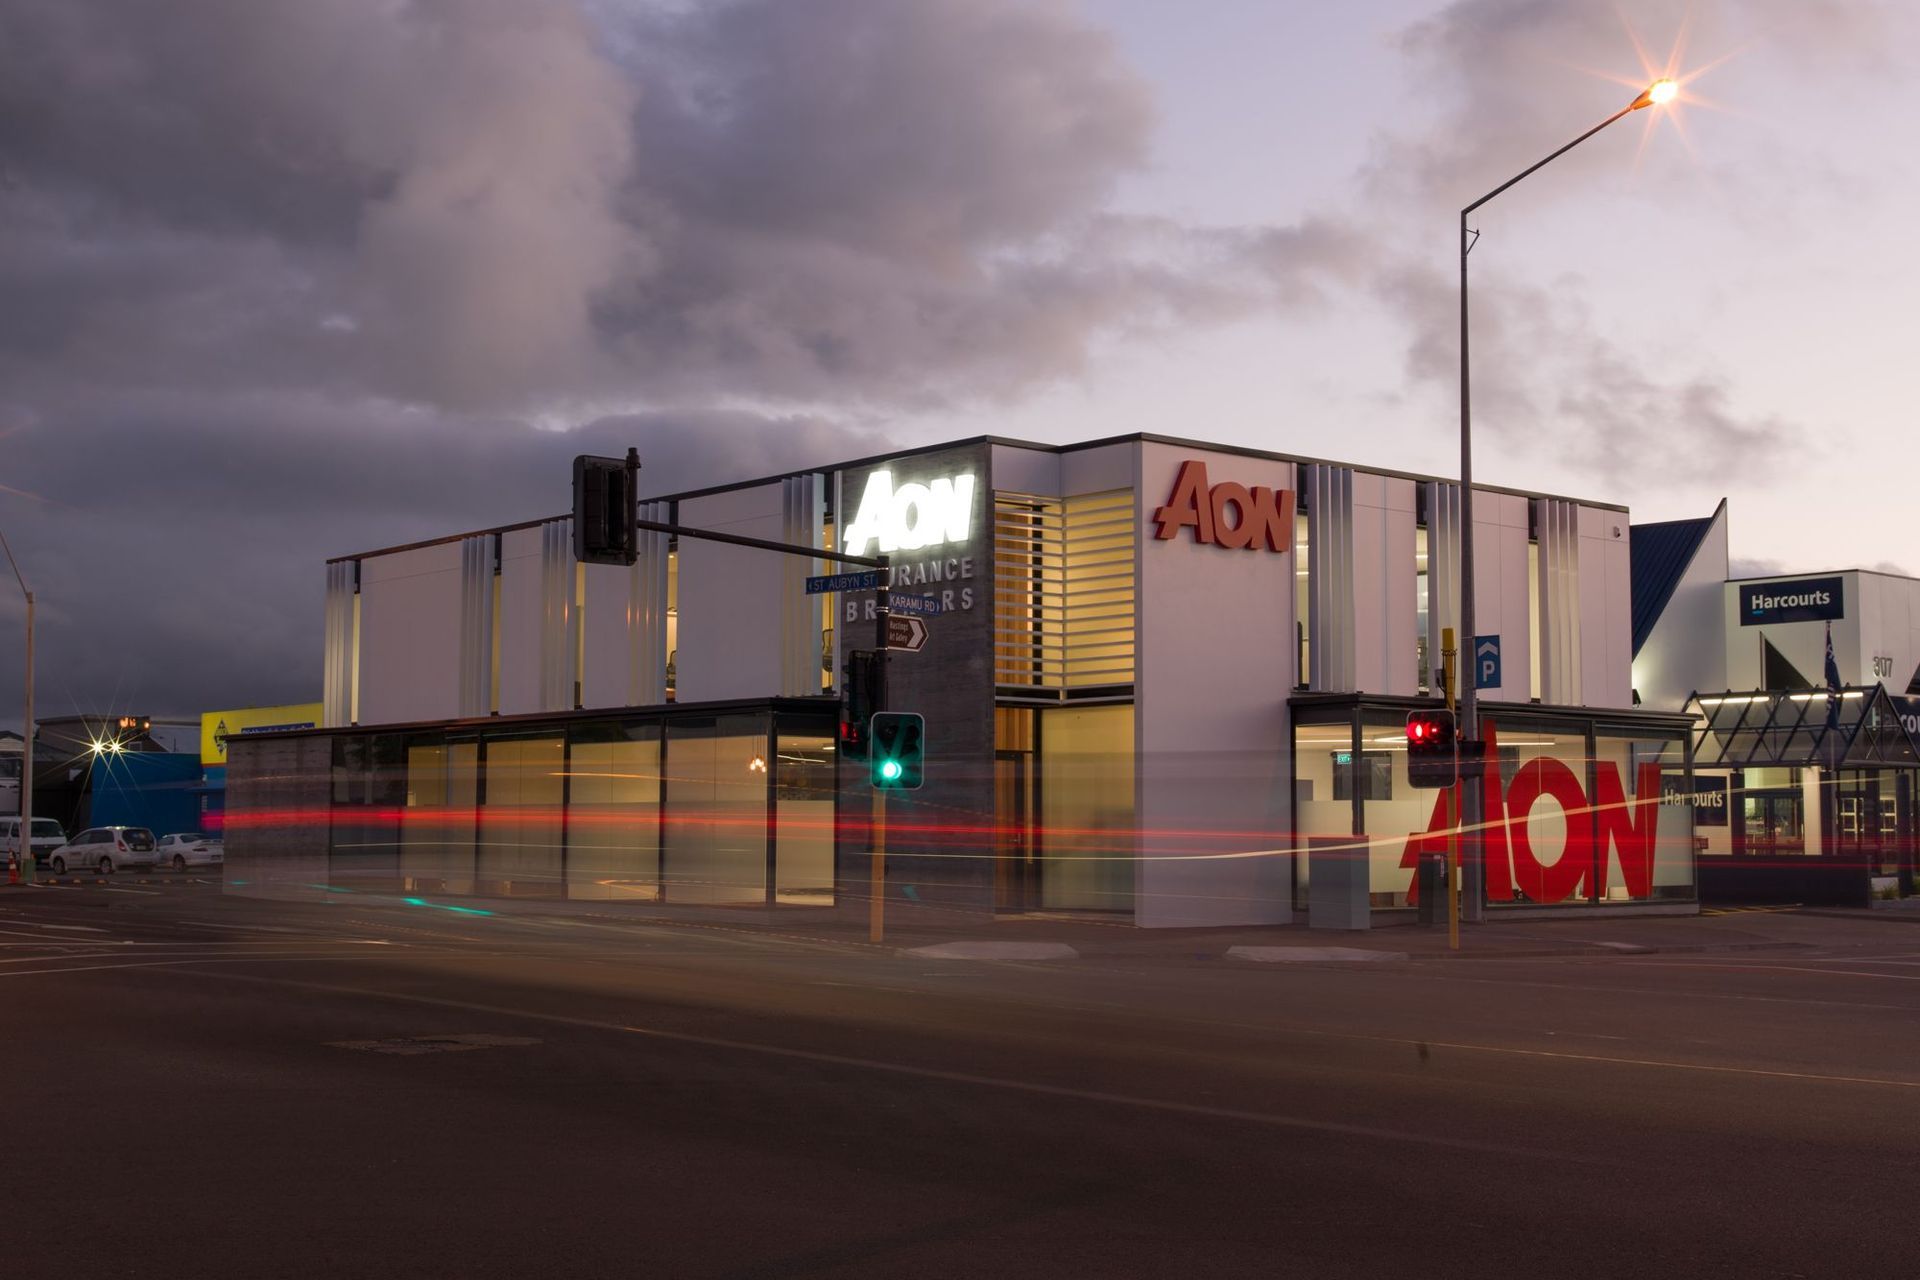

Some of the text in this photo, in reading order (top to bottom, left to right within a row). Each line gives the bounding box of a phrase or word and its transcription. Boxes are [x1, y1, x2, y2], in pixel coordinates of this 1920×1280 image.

[814, 574, 874, 591] ST AUBYN ST
[846, 587, 973, 622] BRRS
[889, 595, 935, 612] KARAMU RD
[1751, 590, 1831, 610] Harcourts
[1483, 660, 1495, 682] P
[1873, 656, 1893, 678] 307
[1664, 789, 1723, 807] Harourts
